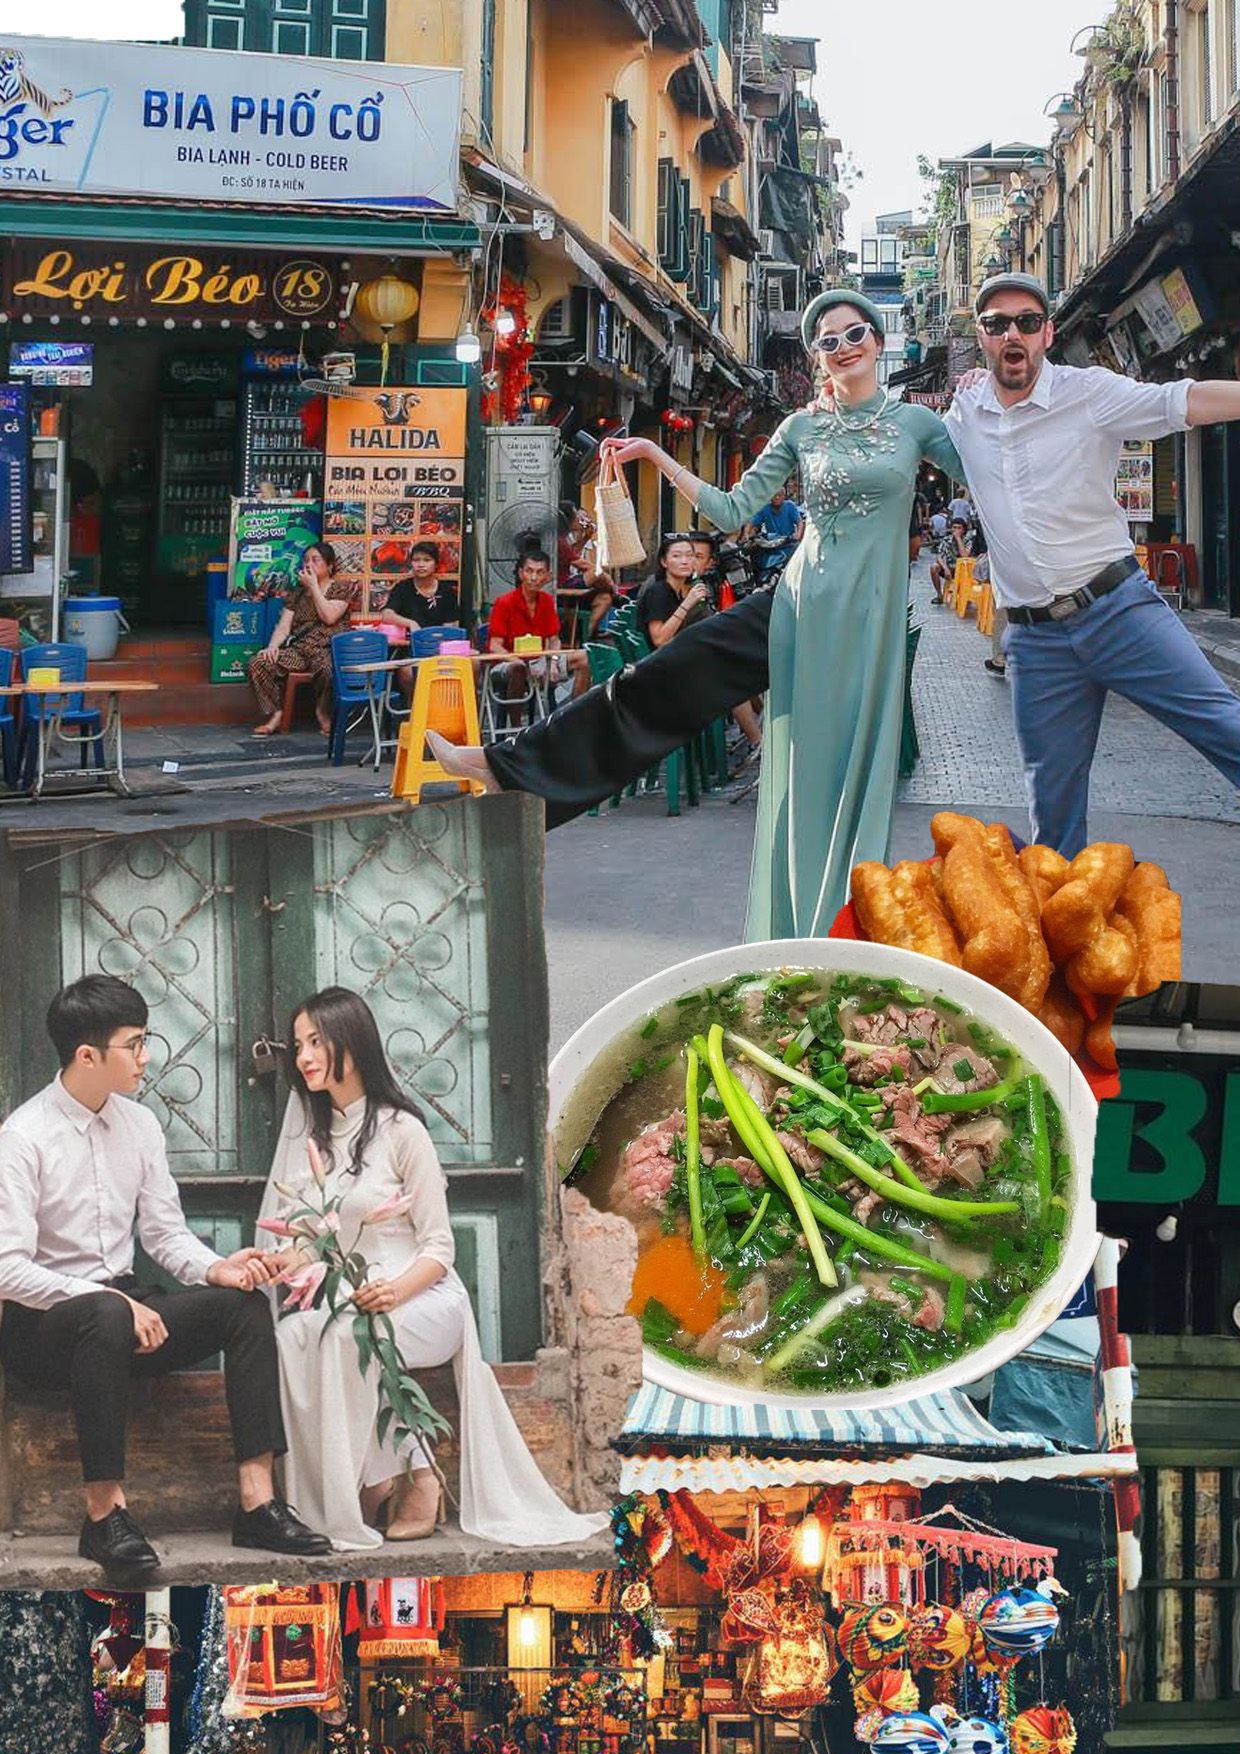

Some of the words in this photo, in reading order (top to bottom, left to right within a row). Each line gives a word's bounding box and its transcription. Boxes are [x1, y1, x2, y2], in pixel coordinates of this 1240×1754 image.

[143, 89, 215, 132] BIA
[231, 89, 321, 137] PHỐ
[329, 91, 385, 142] CỔ
[177, 147, 204, 163] BIA
[208, 149, 250, 167] LẠNH
[266, 152, 305, 169] COLD
[310, 155, 348, 171] BEER
[0, 166, 52, 183] STAL
[13, 251, 128, 310] Lợi
[146, 256, 265, 304] Béo
[280, 268, 325, 297] 18
[350, 428, 440, 449] HALIDA
[331, 467, 365, 481] BIA
[414, 464, 457, 481] BÉO
[411, 487, 450, 498] BBQ
